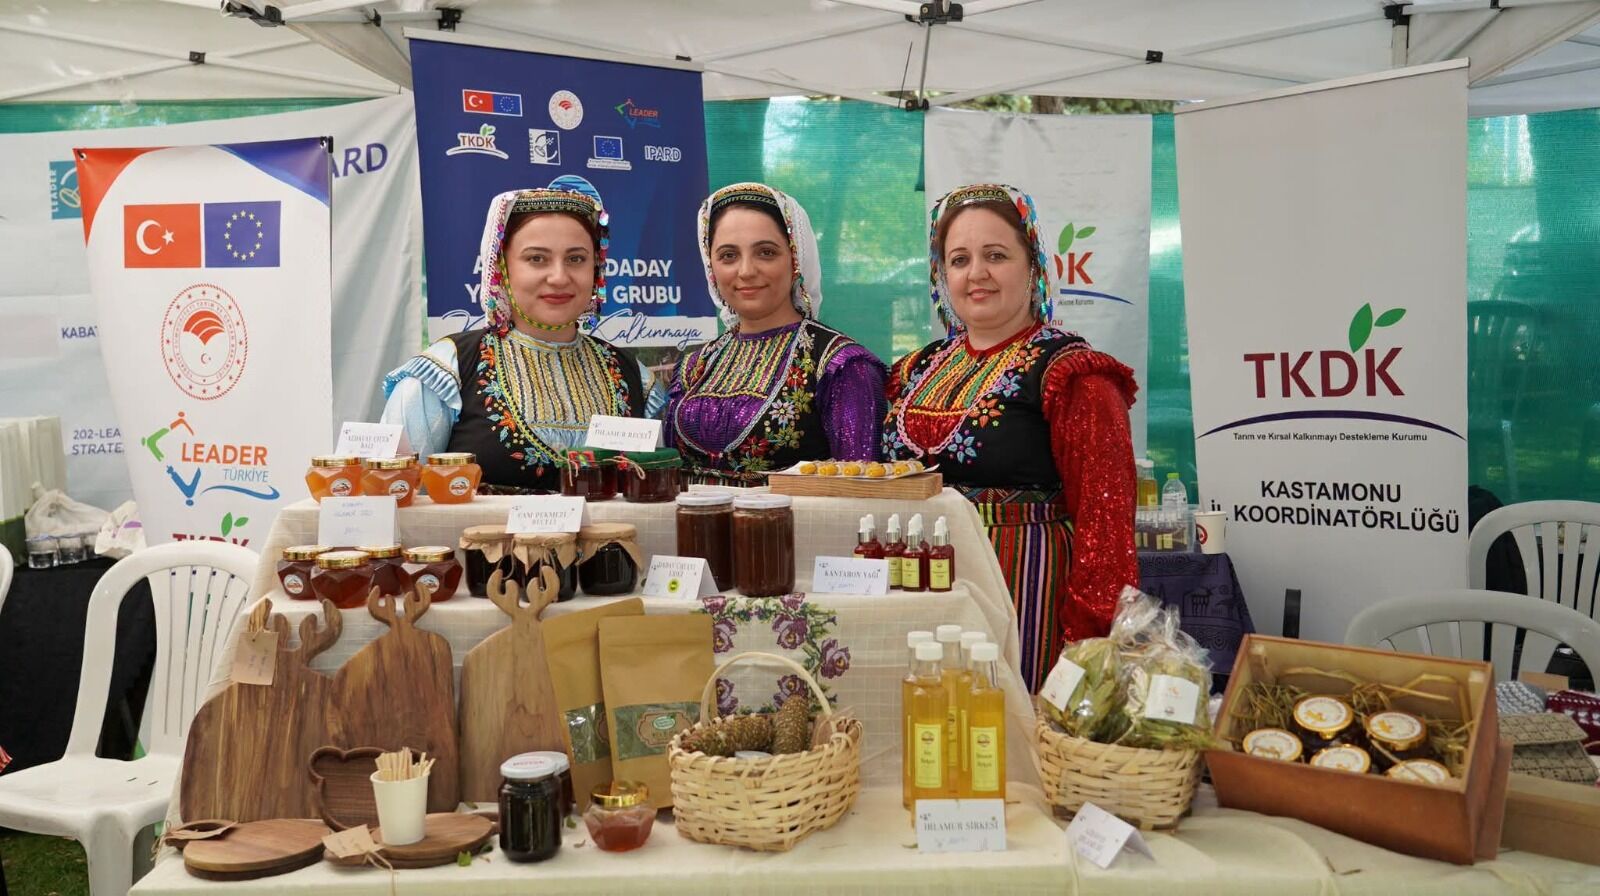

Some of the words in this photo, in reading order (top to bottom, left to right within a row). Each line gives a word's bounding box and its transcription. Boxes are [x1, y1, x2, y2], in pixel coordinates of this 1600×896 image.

[629, 108, 658, 117] LEADER
[460, 135, 494, 148] TKDK
[644, 145, 682, 162] IPARD
[49, 170, 59, 212] LEADER
[604, 258, 673, 277] DADAY
[612, 285, 682, 304] GRUBU
[61, 326, 97, 339] KABA
[1243, 346, 1406, 398] TKDK
[1233, 432, 1255, 440] Tarım
[1268, 432, 1291, 440] Kırsal
[1293, 432, 1337, 443] Kalkınmayı
[1339, 432, 1390, 441] Destekleme
[1392, 432, 1428, 441] Kurumu
[71, 442, 125, 456] STRATE
[181, 443, 268, 466] LEADER
[223, 466, 269, 482] TÜRKİYE
[1261, 481, 1401, 502] KASTAMONU
[1233, 503, 1460, 534] KOORDİNATÖRLÜĞÜ
